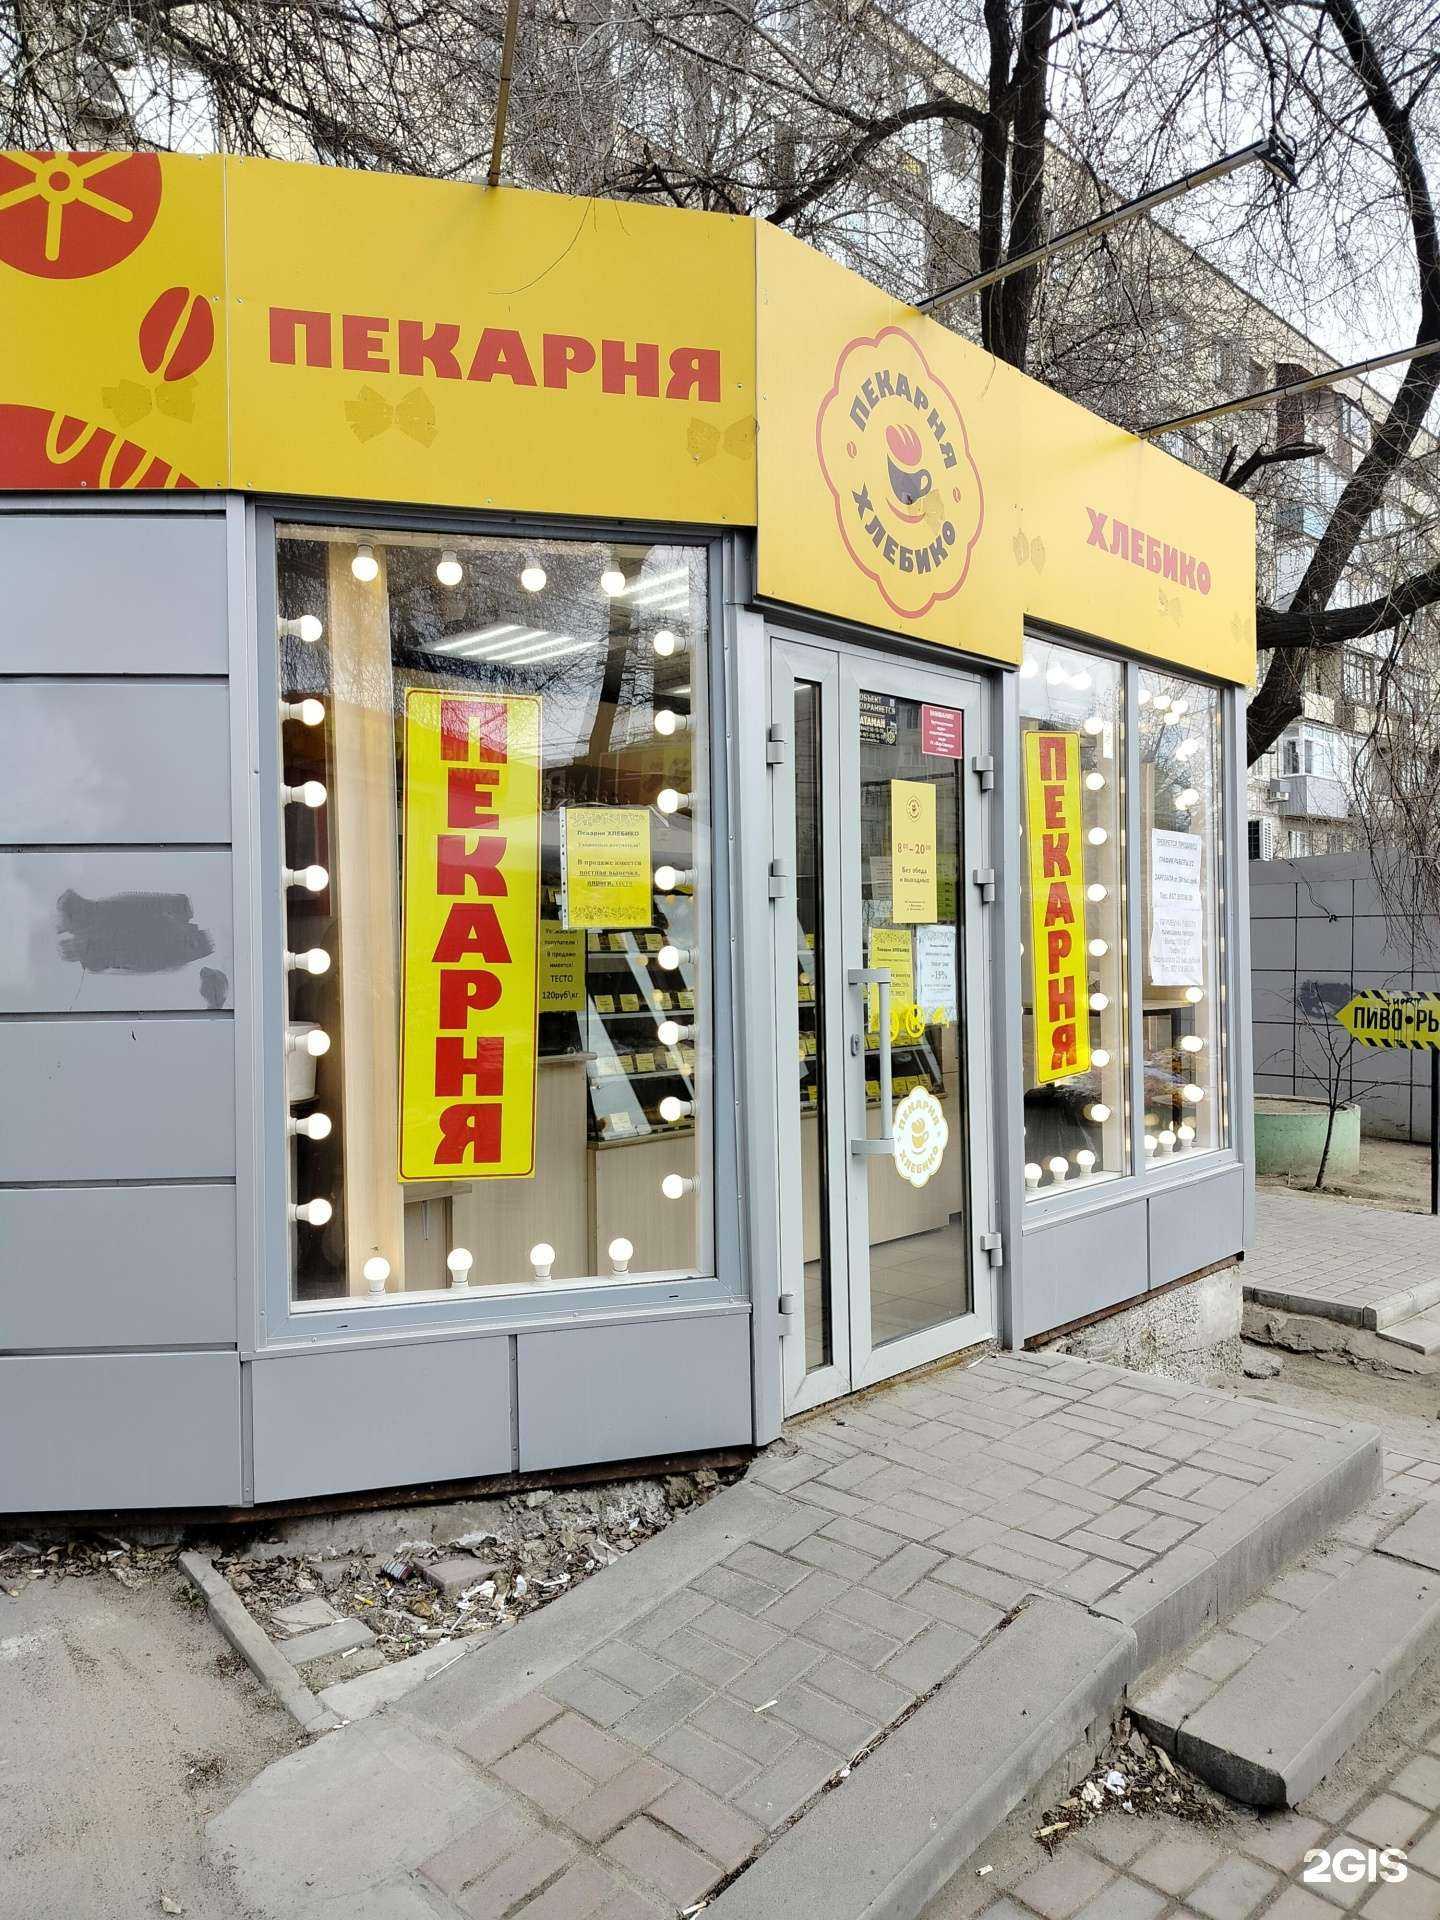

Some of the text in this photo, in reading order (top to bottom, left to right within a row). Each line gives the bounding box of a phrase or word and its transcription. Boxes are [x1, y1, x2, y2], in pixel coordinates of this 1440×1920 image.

[269, 306, 721, 403] ПЕКАРНЯ
[849, 369, 958, 469] ПЕКАРНЯ
[851, 482, 956, 575] ХЛЕБИКО
[1086, 506, 1212, 596] ХЛЕБИКО
[432, 700, 513, 1165] ПЕКАРНЯ
[1039, 736, 1076, 1071] ПЕКАРНЯ
[550, 974, 574, 983] ТЕСТО
[1353, 1006, 1403, 1031] ПИВО
